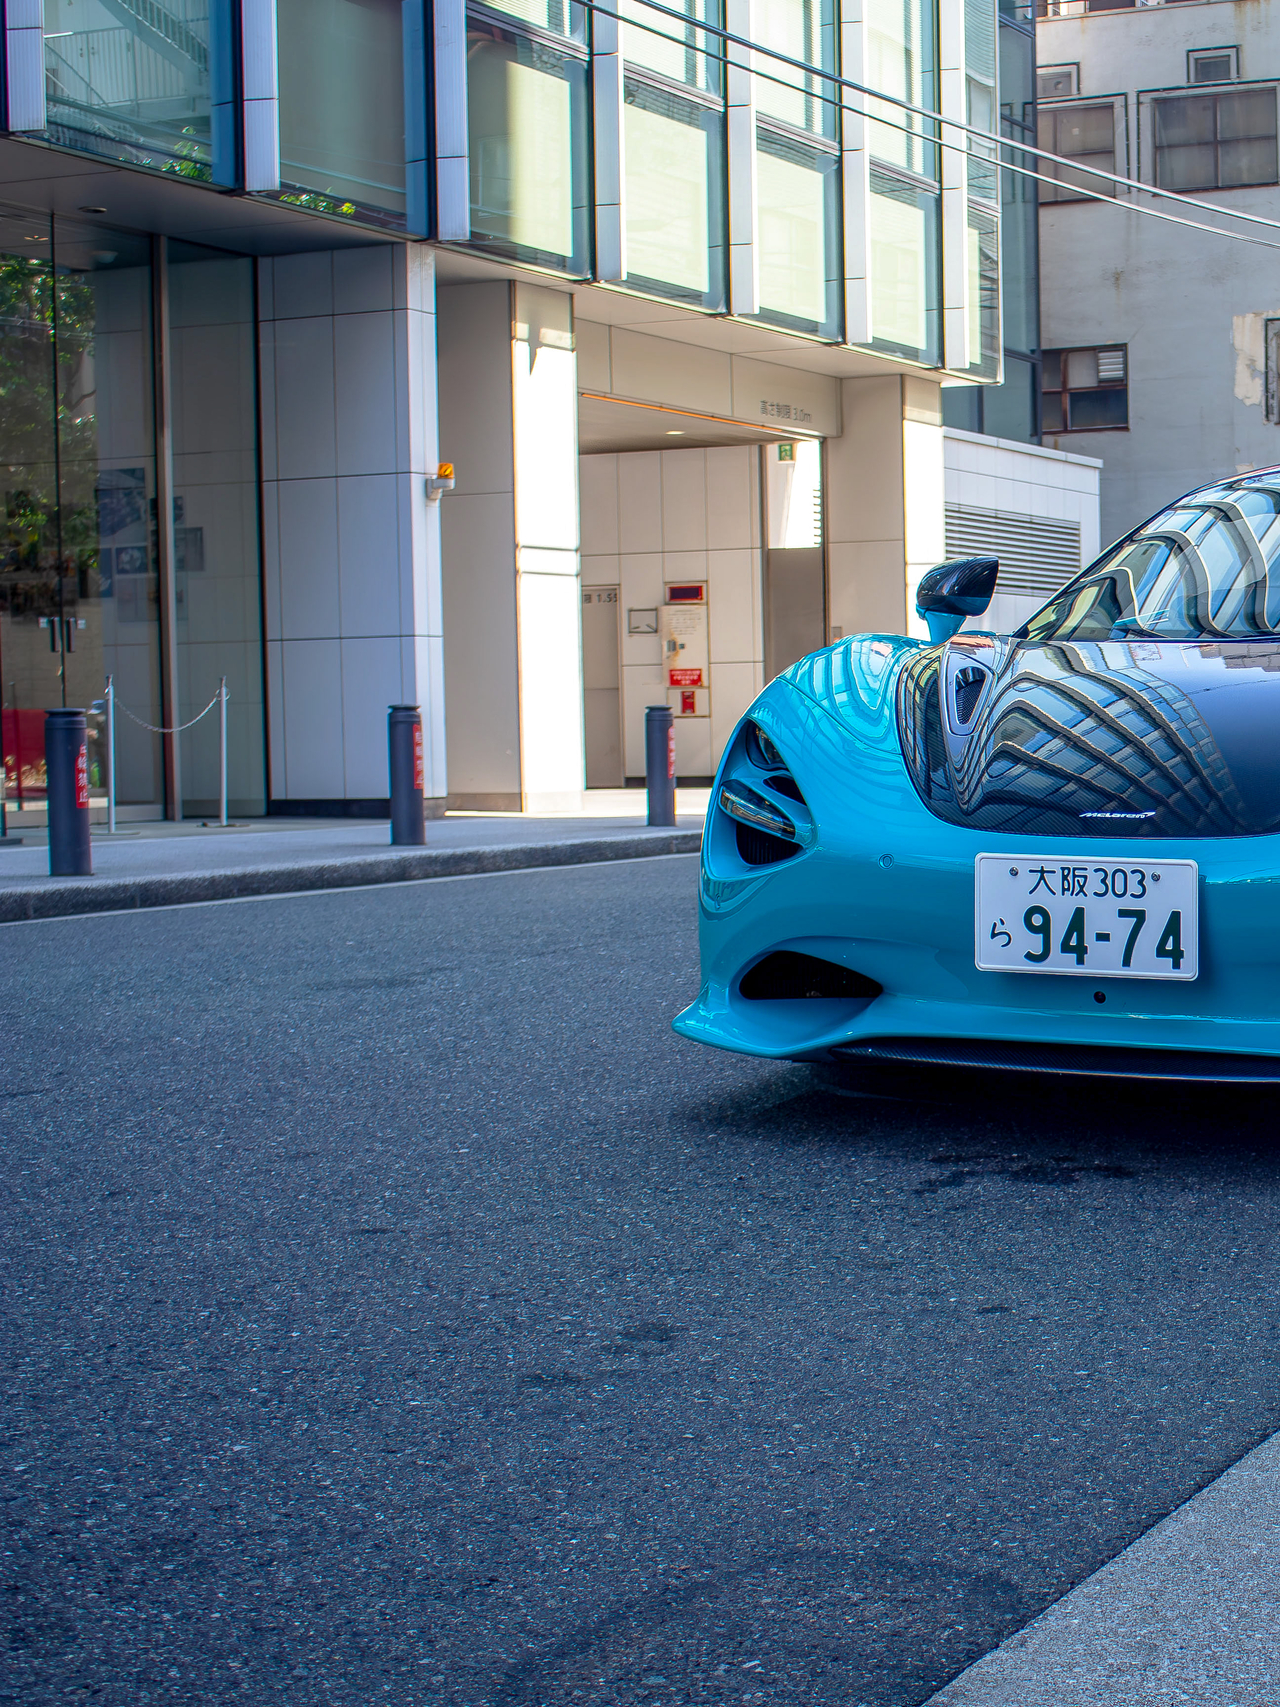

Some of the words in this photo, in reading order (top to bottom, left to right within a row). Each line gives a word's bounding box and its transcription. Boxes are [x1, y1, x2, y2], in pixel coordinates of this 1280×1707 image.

[1079, 811, 1150, 819] McLaren
[990, 917, 1012, 948] ら
[1023, 905, 1185, 970] 94-74
